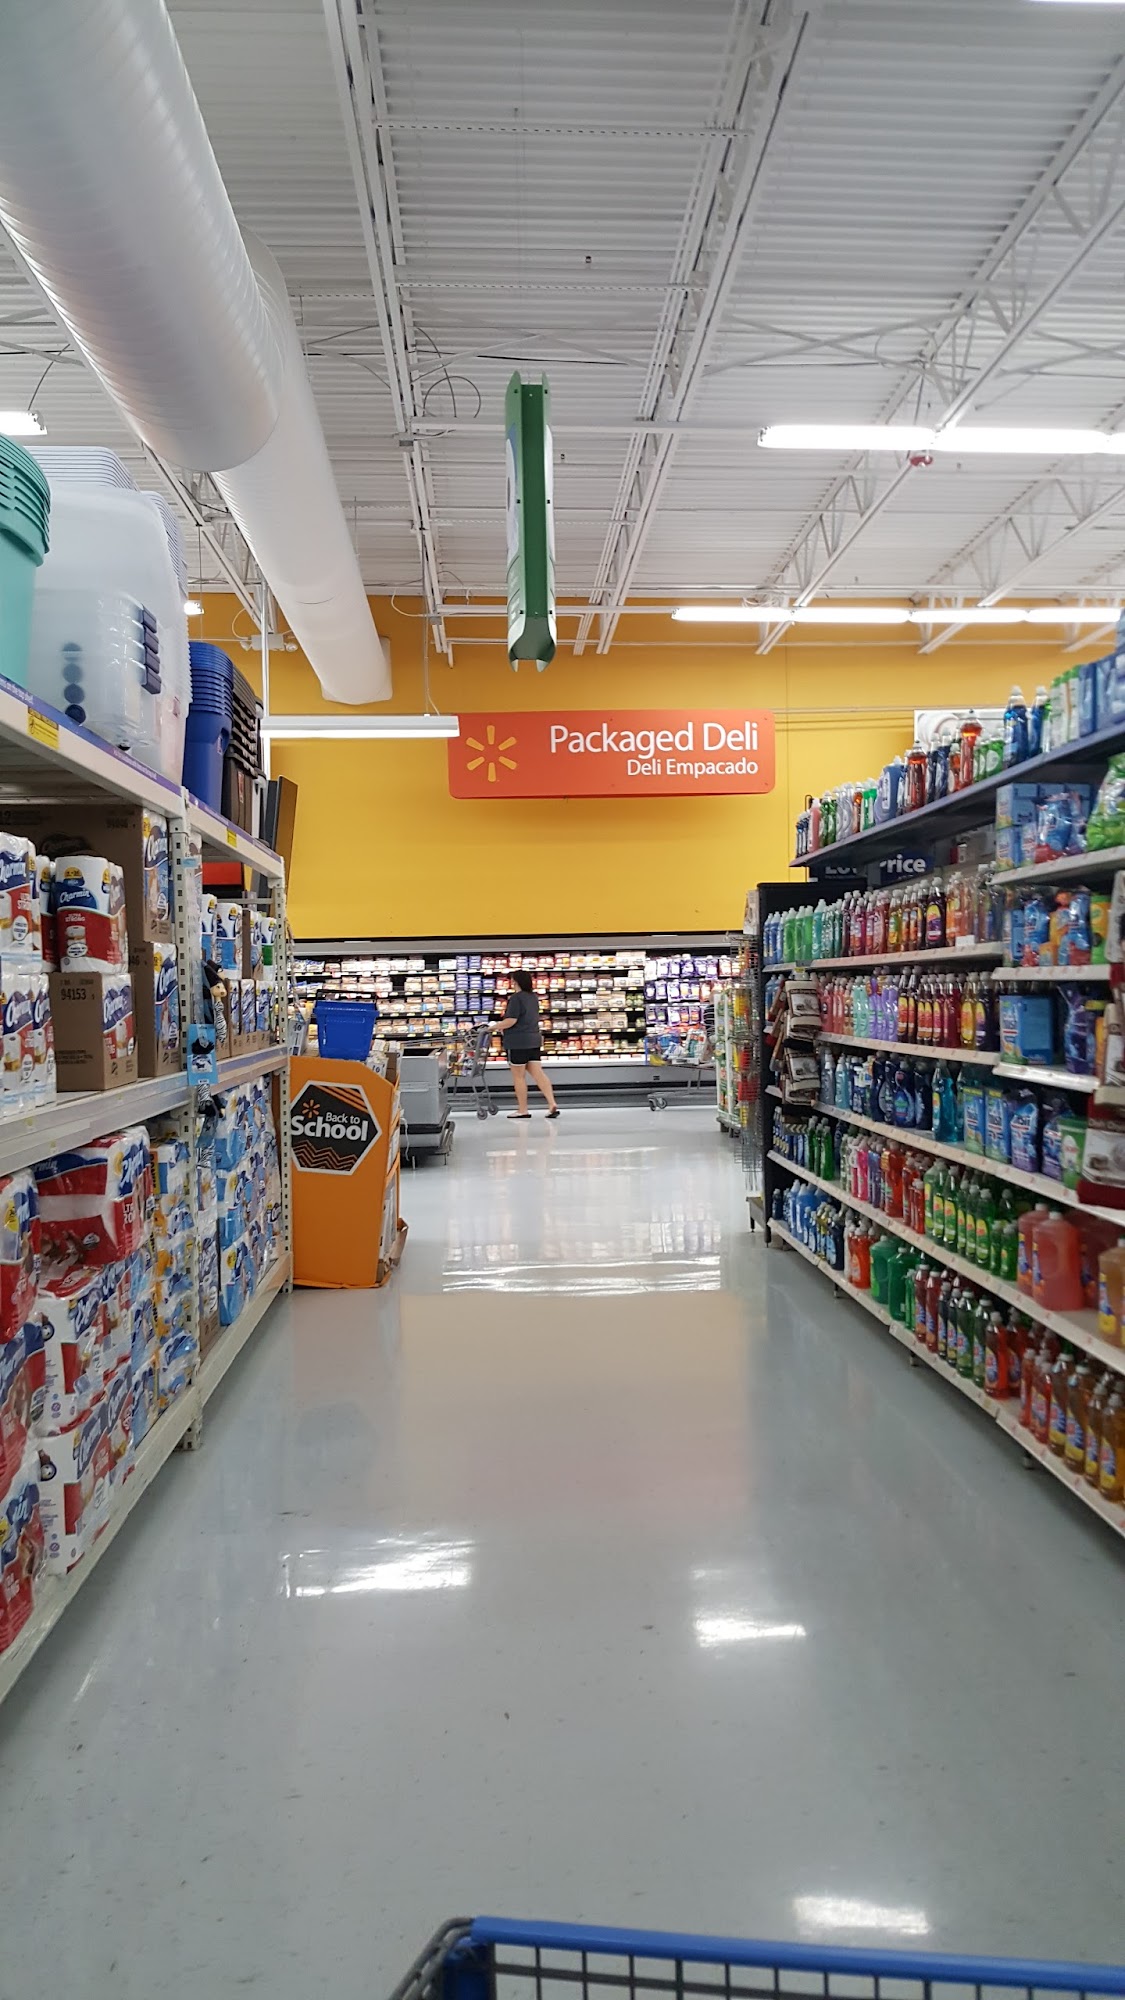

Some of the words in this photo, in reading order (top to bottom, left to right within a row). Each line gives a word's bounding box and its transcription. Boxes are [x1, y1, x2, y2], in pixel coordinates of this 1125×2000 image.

[550, 722, 693, 759] Packaged
[703, 720, 758, 752] Deli
[627, 758, 661, 776] Deli
[666, 757, 758, 778] Empacado
[60, 889, 90, 902] Charmin
[61, 988, 87, 1001] 94153
[326, 1112, 348, 1123] Back
[349, 1114, 361, 1124] to
[292, 1116, 368, 1141] School
